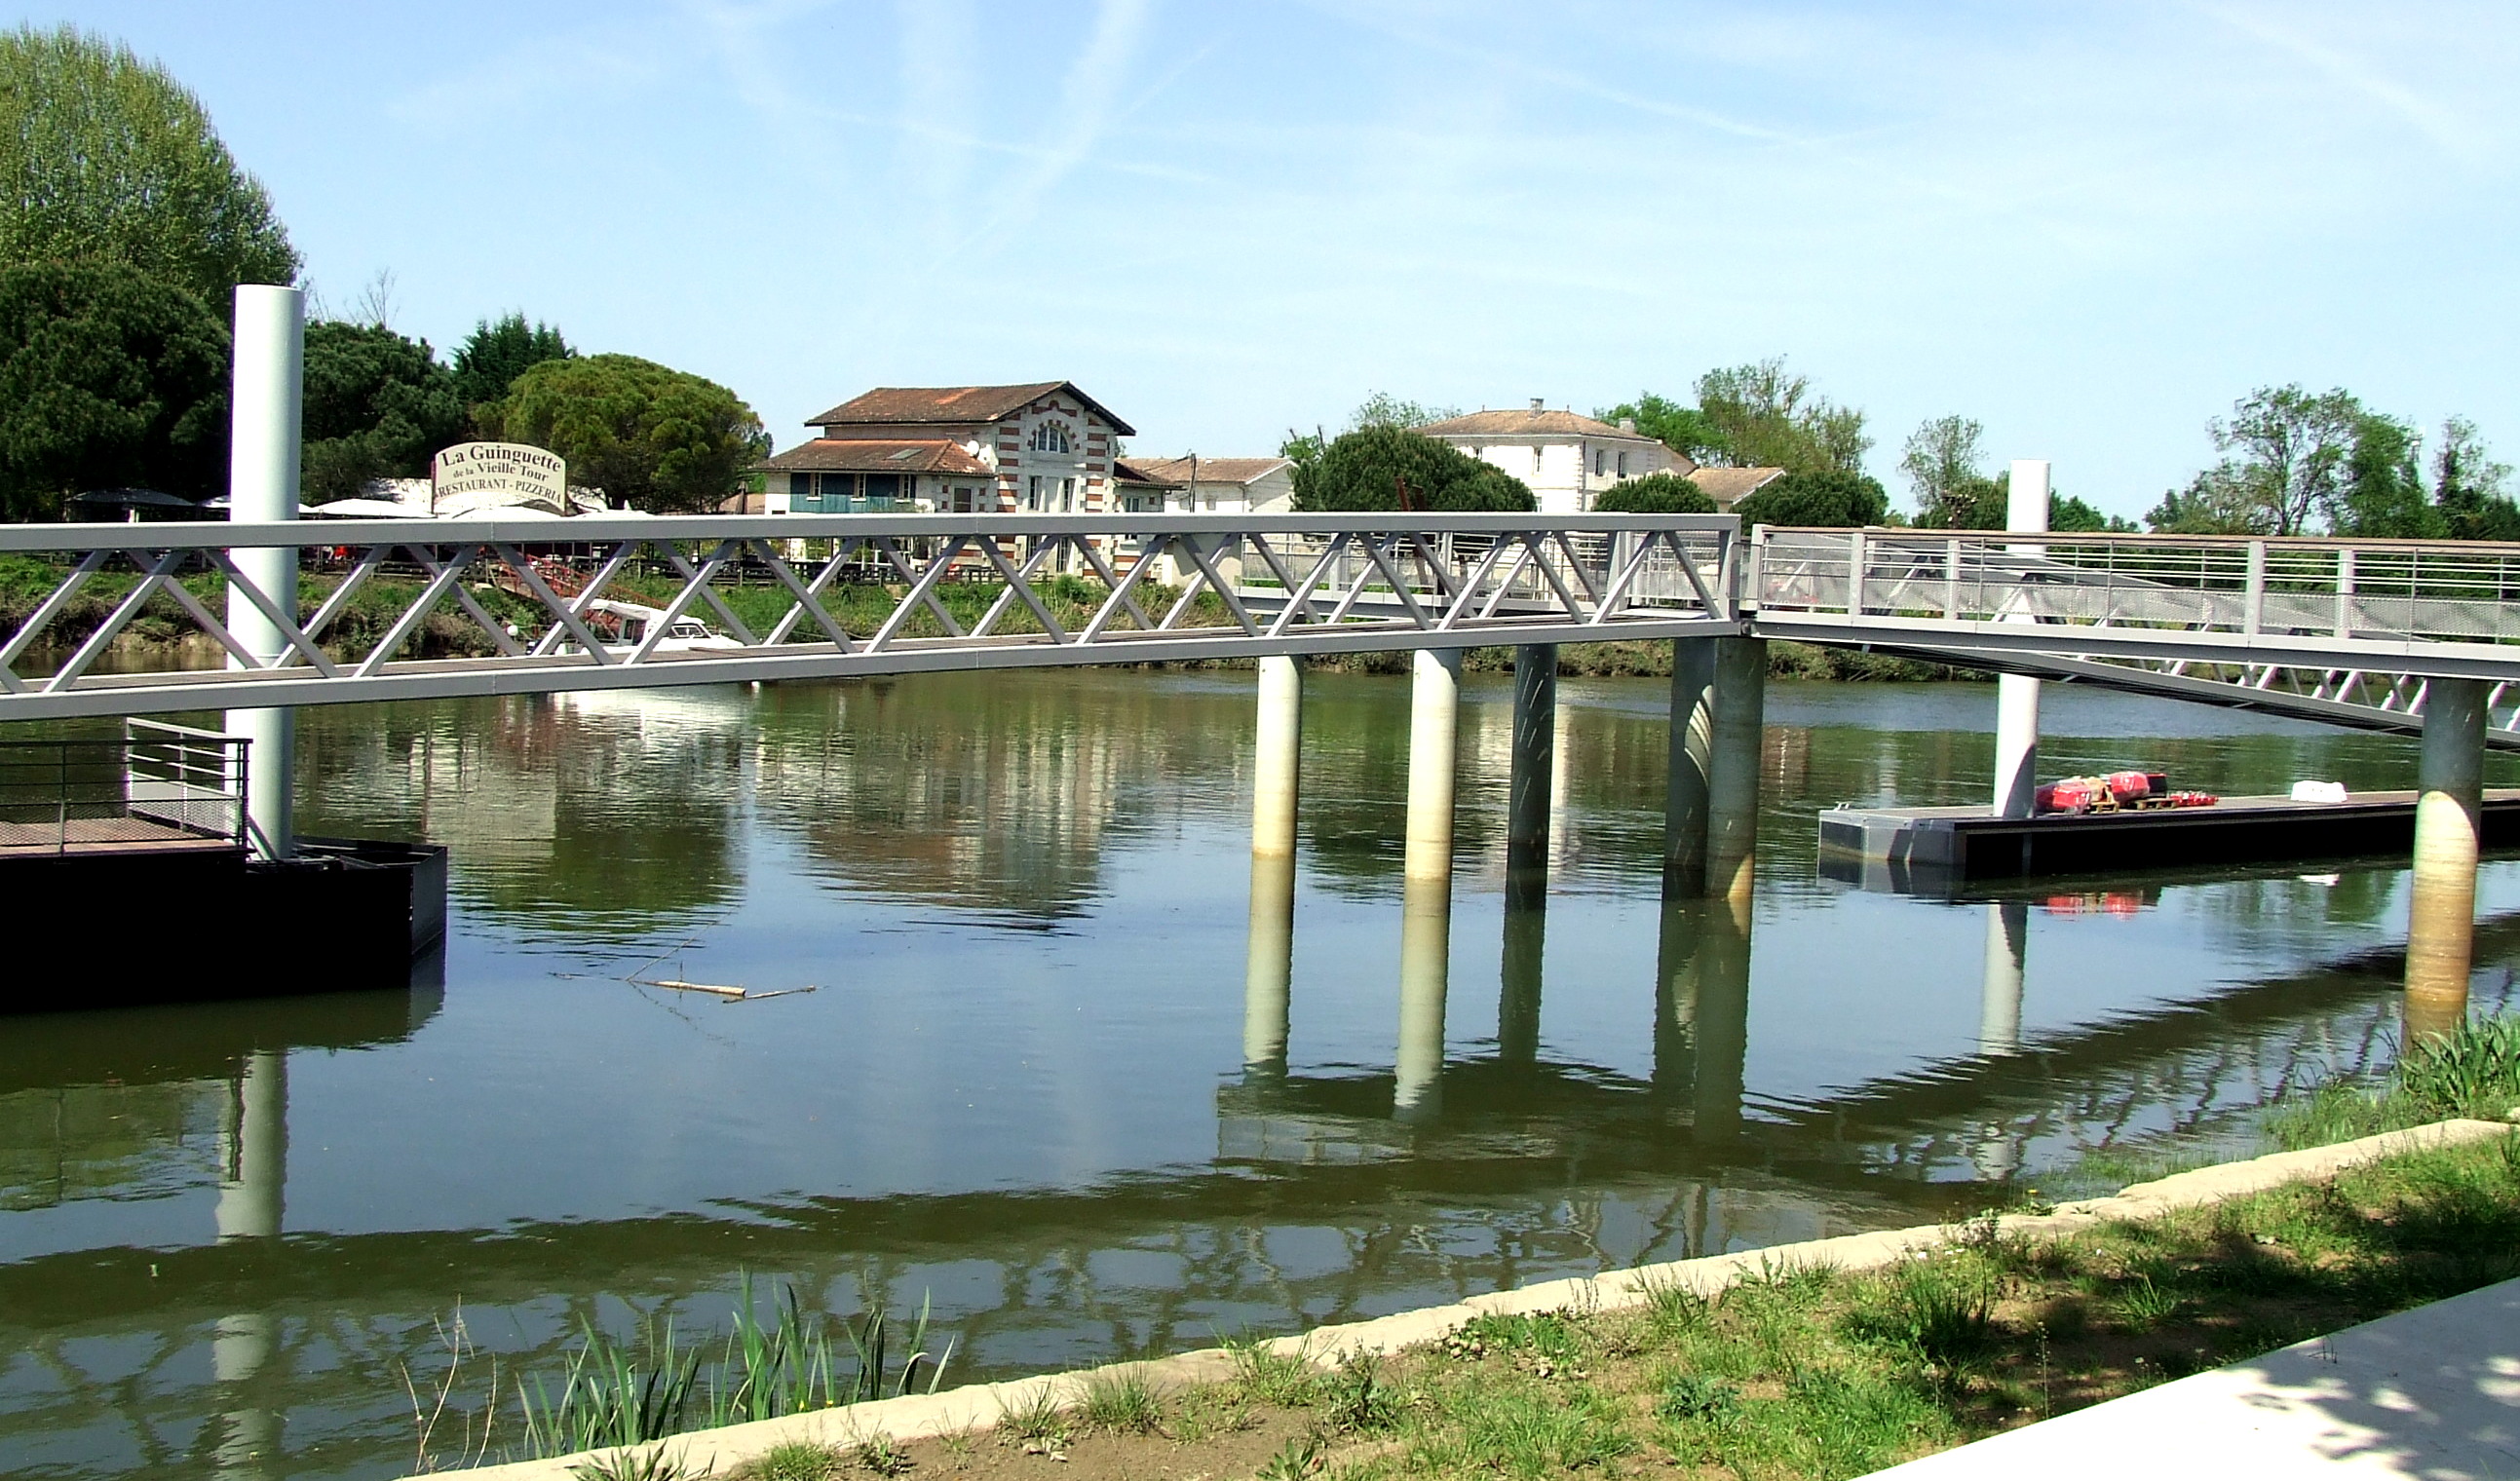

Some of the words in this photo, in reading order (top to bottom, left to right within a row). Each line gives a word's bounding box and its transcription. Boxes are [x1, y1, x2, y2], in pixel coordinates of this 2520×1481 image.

[441, 452, 465, 467] La
[470, 445, 561, 473] Guinguette
[453, 470, 464, 478] de
[466, 467, 475, 475] la
[477, 462, 516, 475] Vieille
[520, 464, 549, 482] Tour
[438, 478, 508, 498] RESTAURANT
[515, 480, 561, 503] PIZZERIA
